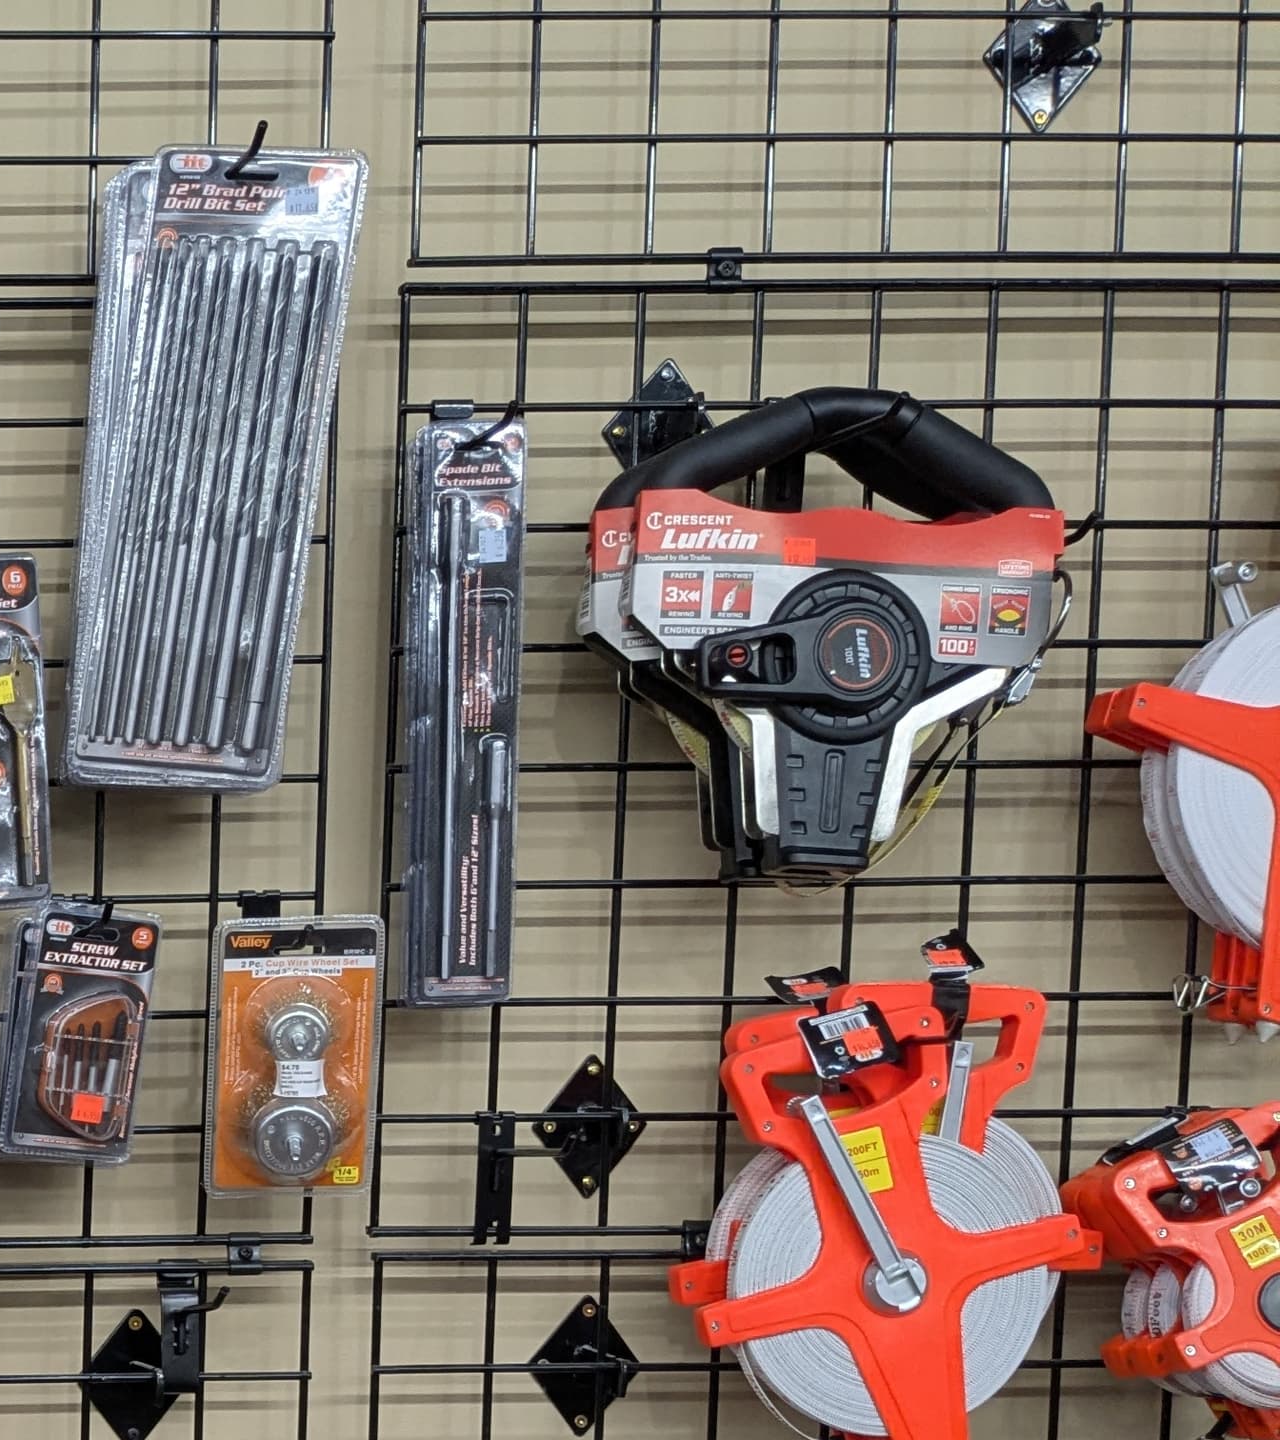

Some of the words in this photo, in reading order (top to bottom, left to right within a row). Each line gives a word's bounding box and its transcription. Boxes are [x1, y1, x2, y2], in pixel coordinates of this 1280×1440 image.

[203, 184, 246, 198] Brad
[163, 198, 202, 210] Drill
[203, 199, 230, 212] Bit
[233, 200, 267, 212] Set
[439, 465, 479, 476] Spade
[481, 464, 502, 473] Bit
[440, 476, 512, 486] Extensions
[664, 515, 733, 525] CRESCENT
[660, 529, 759, 550] Lufkin
[10, 571, 21, 583] 6
[854, 628, 872, 679] Lufkin
[139, 932, 148, 941] 5
[231, 935, 273, 949] Valley
[70, 942, 119, 955] SCREW
[43, 952, 117, 970] EXTRACTOR
[118, 958, 148, 973] SET
[265, 960, 285, 969] Cup
[310, 958, 340, 967] Wheel
[342, 958, 359, 966] Set
[311, 967, 340, 975] Wheels
[1238, 1222, 1267, 1242] 30M
